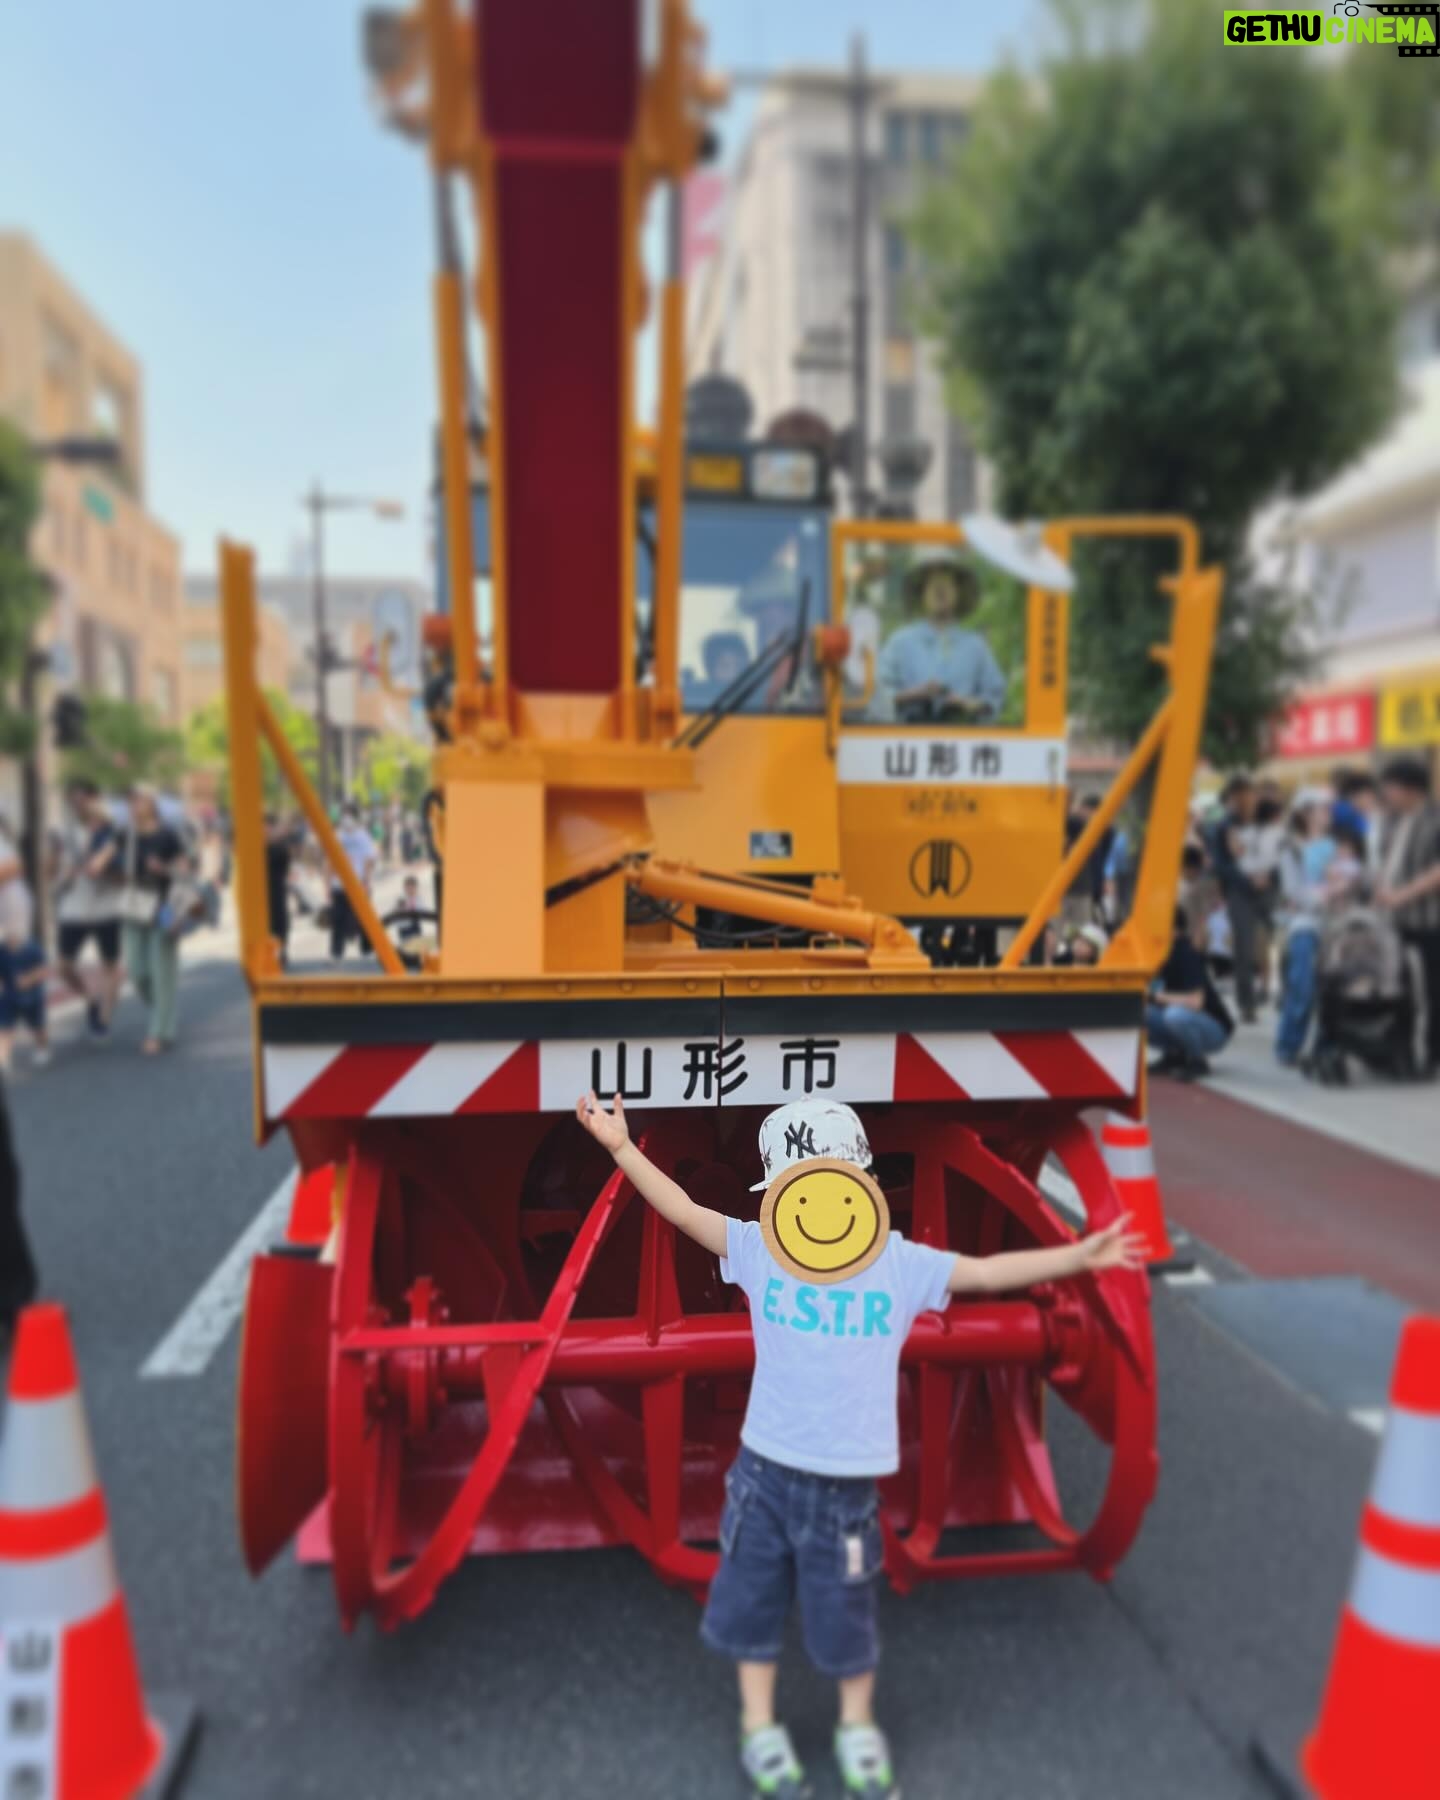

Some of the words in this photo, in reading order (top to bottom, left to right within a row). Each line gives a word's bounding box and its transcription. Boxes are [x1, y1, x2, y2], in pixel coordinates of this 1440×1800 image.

[884, 741, 1001, 777] 山形市
[591, 1037, 841, 1101] 山形市
[784, 1120, 818, 1159] NY
[763, 1276, 892, 1337] E.S.T.R
